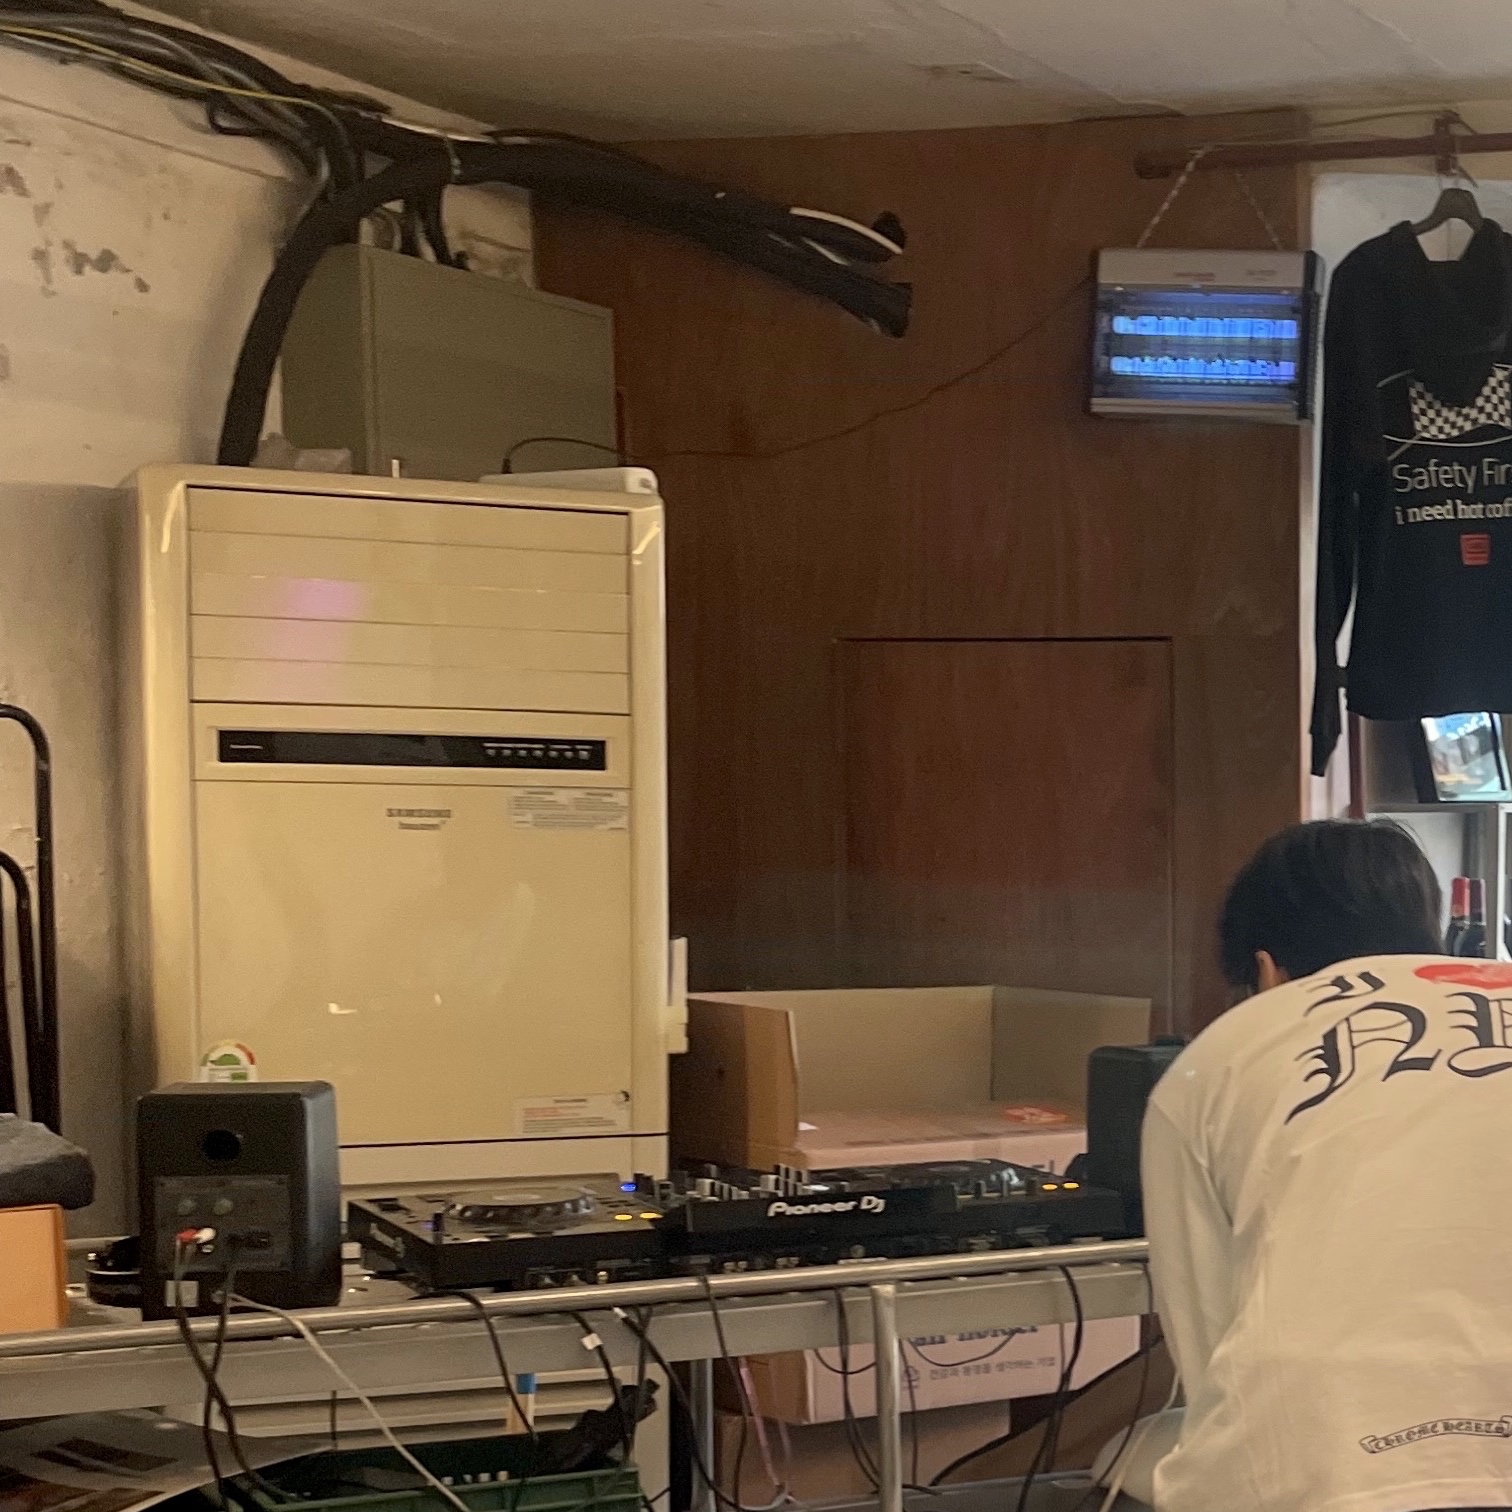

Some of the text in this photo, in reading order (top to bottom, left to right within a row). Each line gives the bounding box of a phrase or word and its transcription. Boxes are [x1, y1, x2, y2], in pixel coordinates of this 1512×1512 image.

[1392, 457, 1477, 494] Safety
[1395, 504, 1405, 525] i
[1407, 499, 1456, 523] need
[1456, 498, 1485, 521] hot
[767, 1200, 858, 1217] Pioneer
